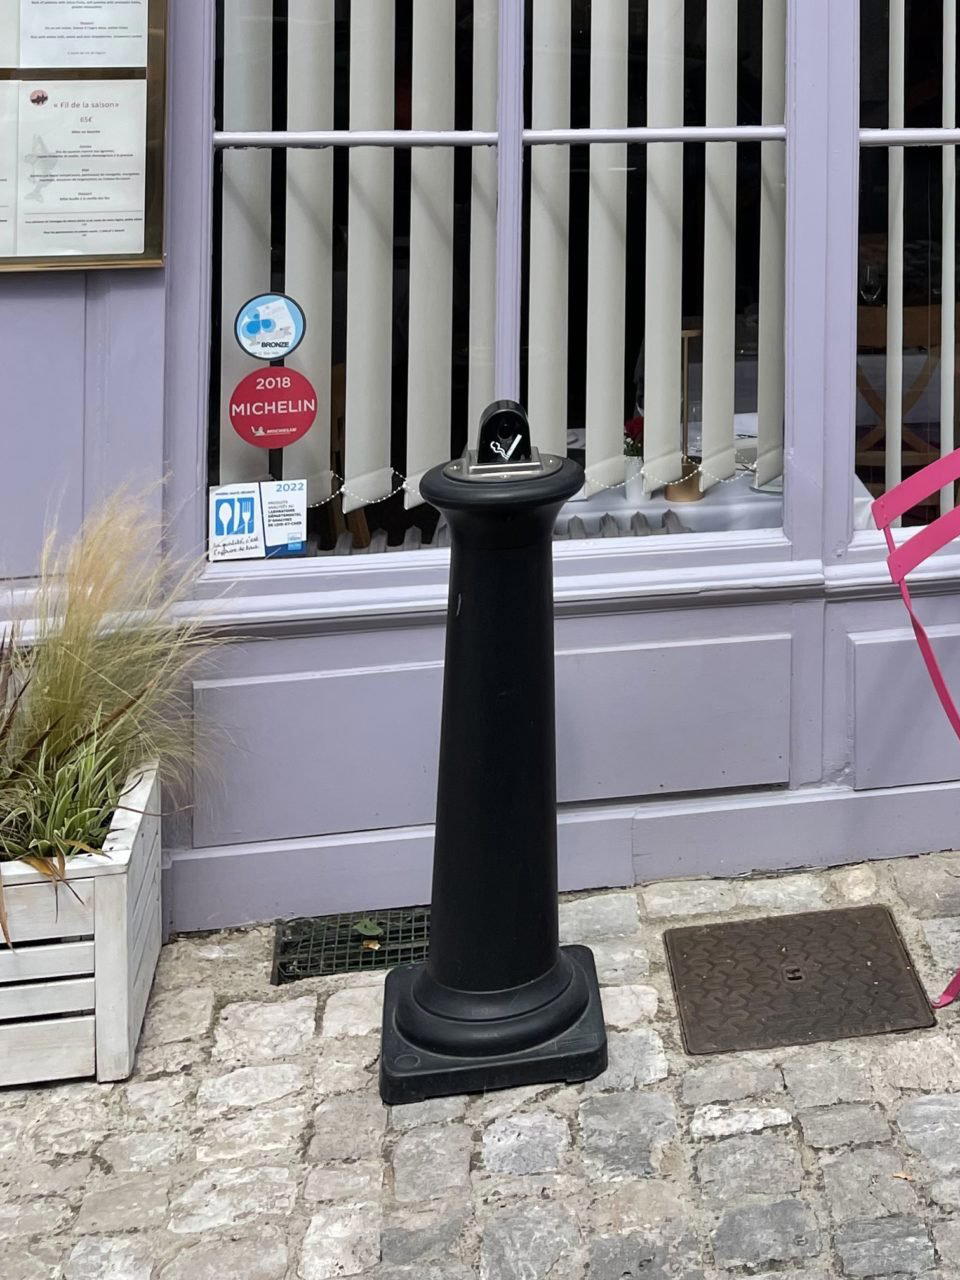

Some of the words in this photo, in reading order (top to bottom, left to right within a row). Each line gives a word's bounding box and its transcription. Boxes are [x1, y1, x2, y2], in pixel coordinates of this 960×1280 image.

[255, 376, 292, 390] 2018
[231, 398, 316, 417] MICHELIN
[275, 482, 305, 493] 2022
